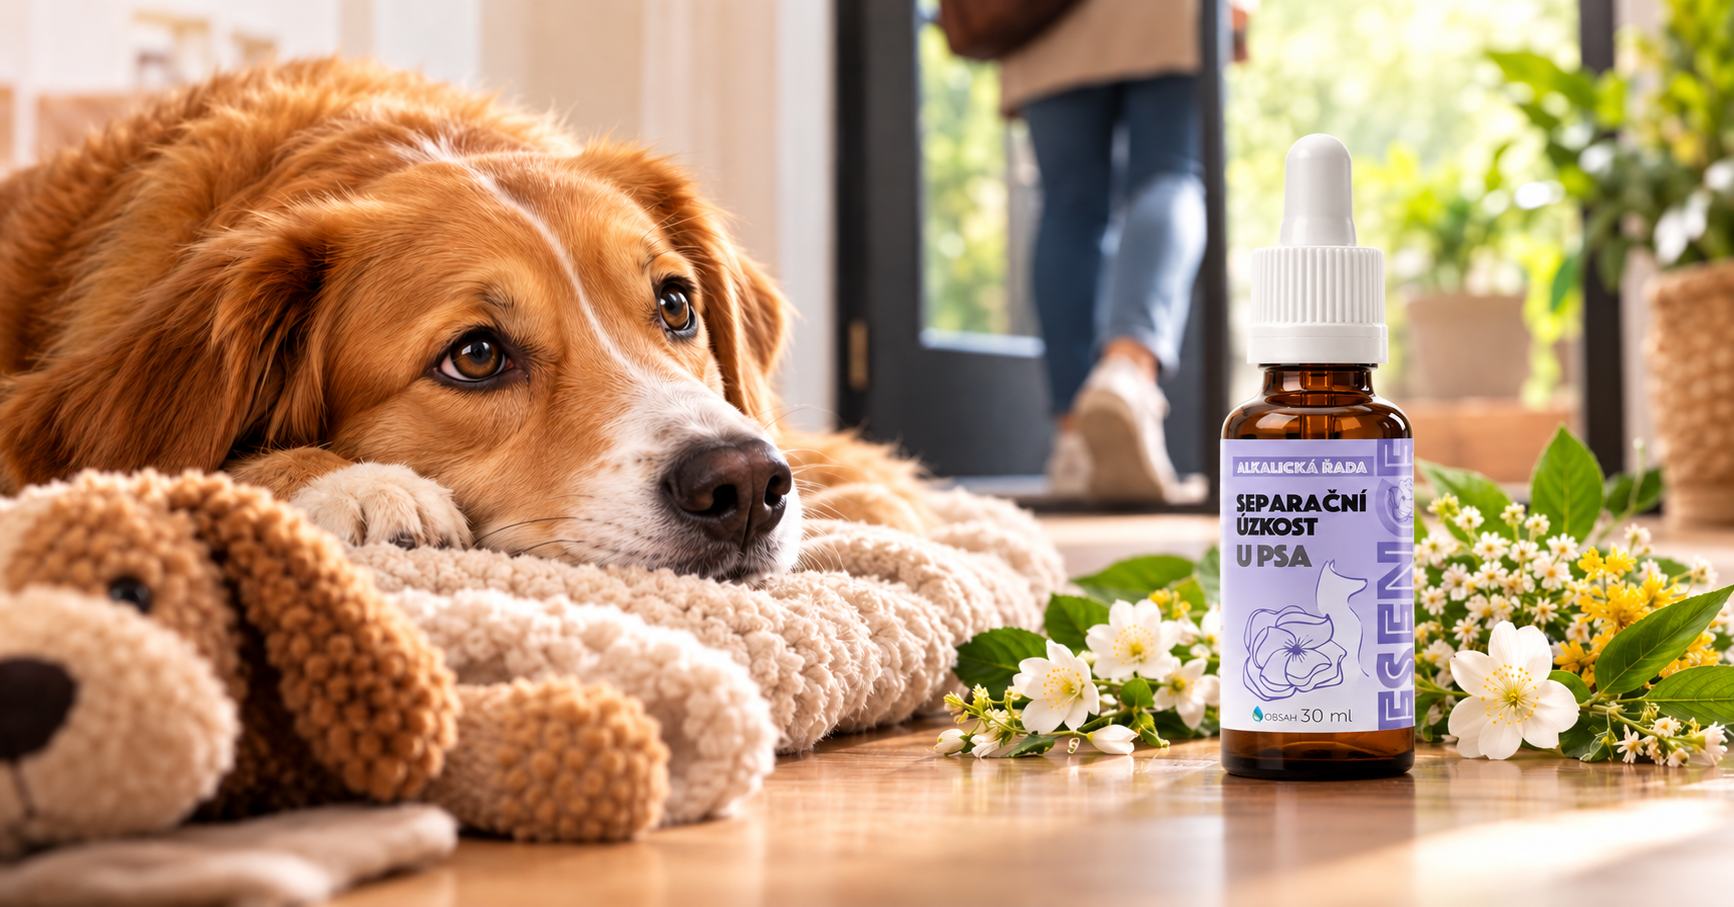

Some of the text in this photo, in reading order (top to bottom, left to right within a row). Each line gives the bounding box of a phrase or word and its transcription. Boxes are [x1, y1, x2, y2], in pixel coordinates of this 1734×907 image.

[1236, 458, 1368, 474] ALKALICKÁ ŘADA
[1236, 489, 1368, 513] SEPARAČNÍ
[1236, 512, 1319, 536] ÚZKOST
[1236, 544, 1313, 568] U PSA
[1264, 708, 1353, 723] OBSAH 30 ml
